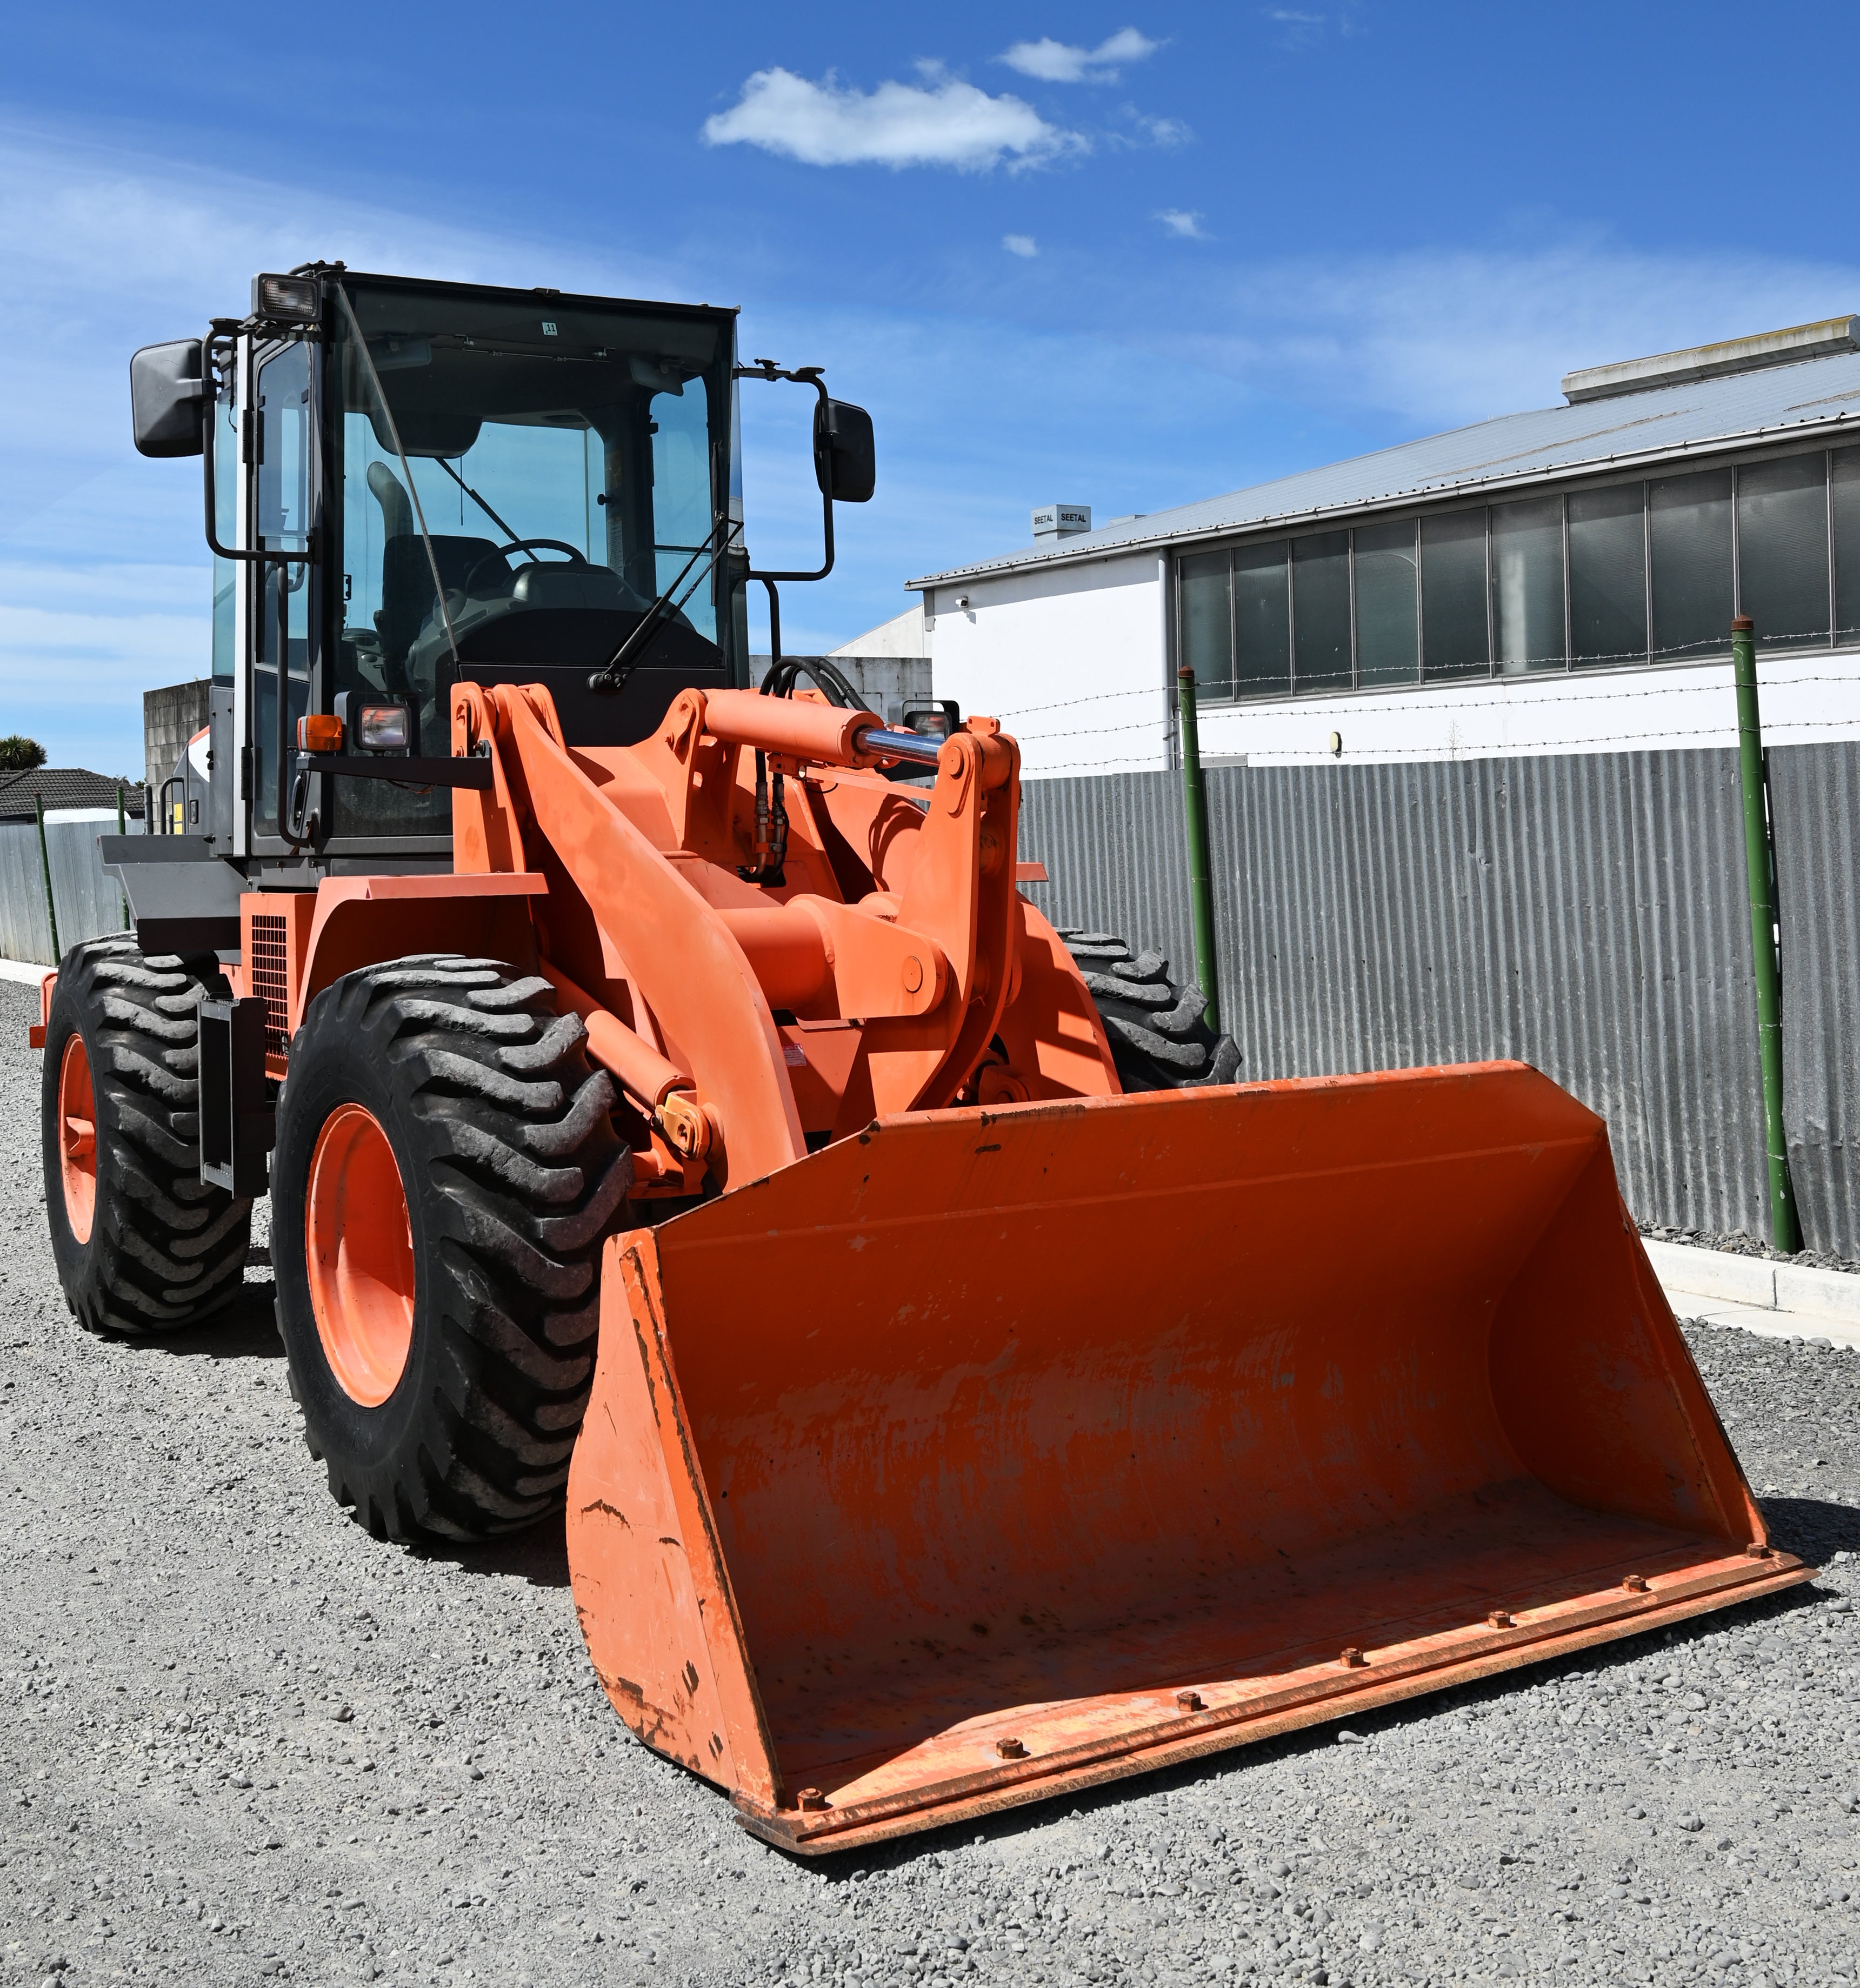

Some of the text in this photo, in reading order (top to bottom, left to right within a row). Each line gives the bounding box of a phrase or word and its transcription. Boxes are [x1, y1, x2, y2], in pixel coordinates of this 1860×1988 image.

[547, 324, 556, 332] 11
[1034, 514, 1054, 524] SEETAL
[1061, 513, 1086, 522] SEETAL
